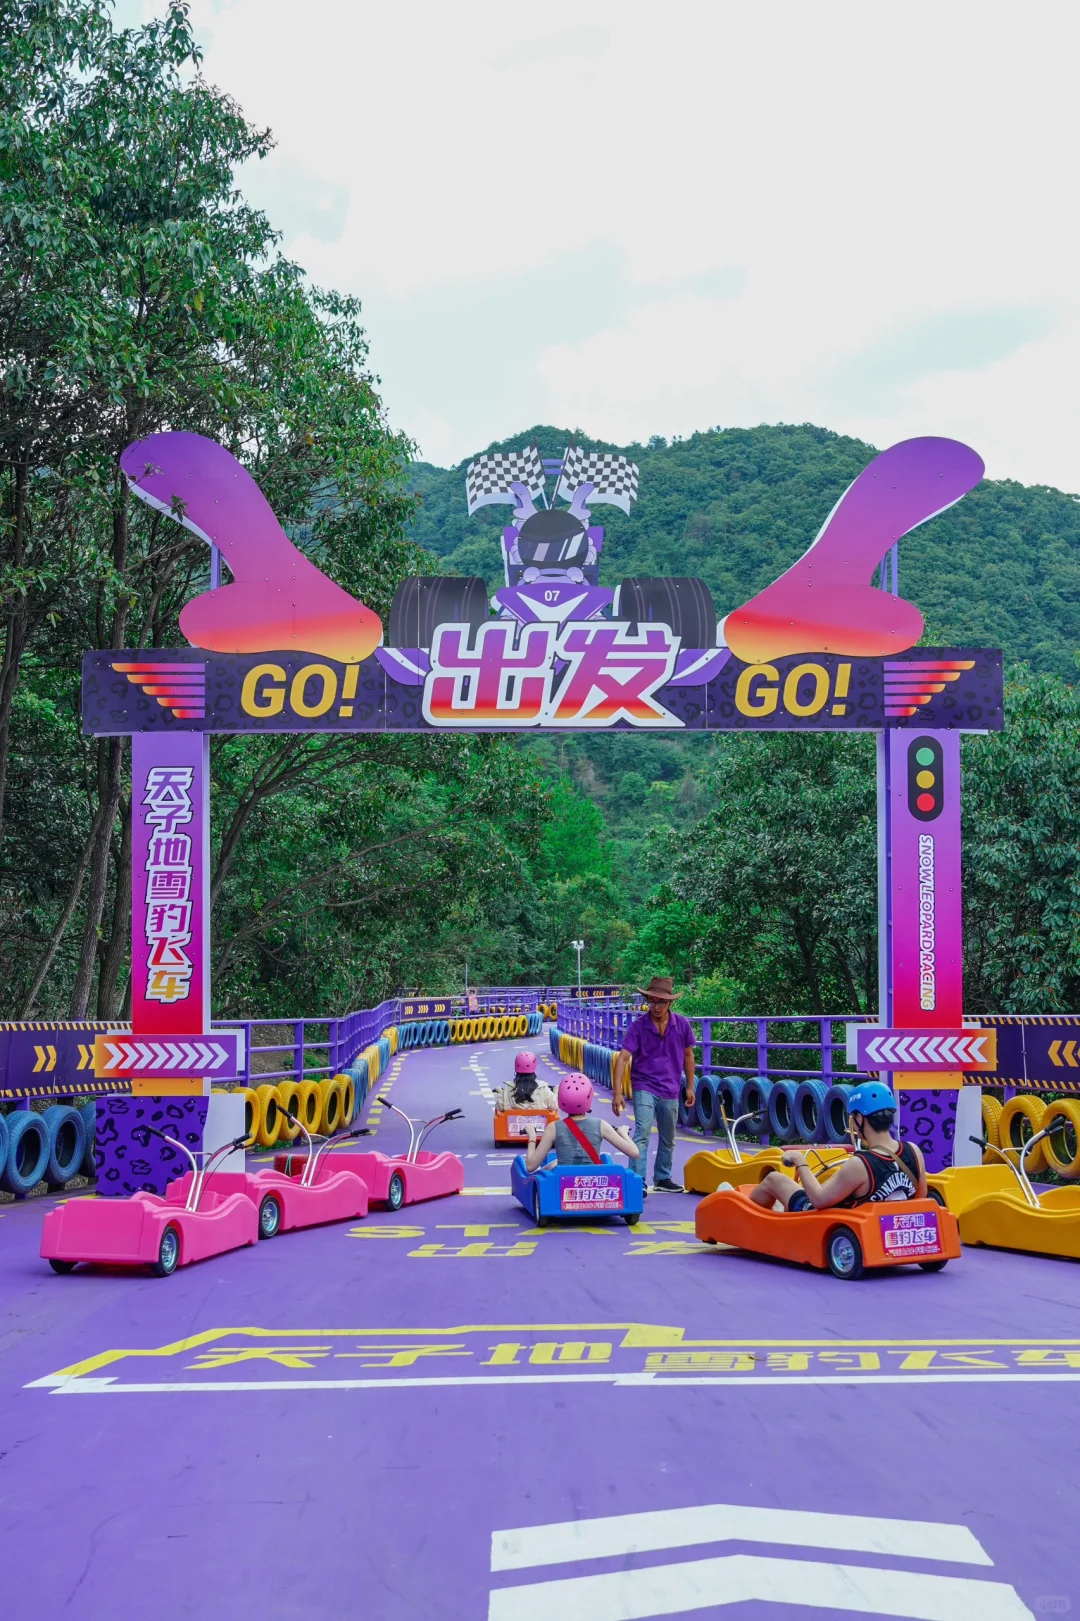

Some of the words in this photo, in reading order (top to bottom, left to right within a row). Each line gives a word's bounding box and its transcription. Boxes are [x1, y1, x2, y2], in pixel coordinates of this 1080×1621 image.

[544, 590, 561, 602] 07
[240, 663, 361, 718] GO!
[422, 621, 686, 727] 出发
[734, 662, 853, 717] GO!
[918, 833, 935, 883] SNOW
[141, 766, 195, 1004] 天子地雪豹飞车
[918, 883, 936, 952] LEOPARD
[919, 951, 936, 1011] RACING
[563, 1187, 620, 1202] 雪豹飞车
[574, 1175, 609, 1187] 天子地
[345, 1221, 696, 1238] STAR
[884, 1227, 937, 1249] 雪豹飞车
[893, 1213, 925, 1229] 天子地
